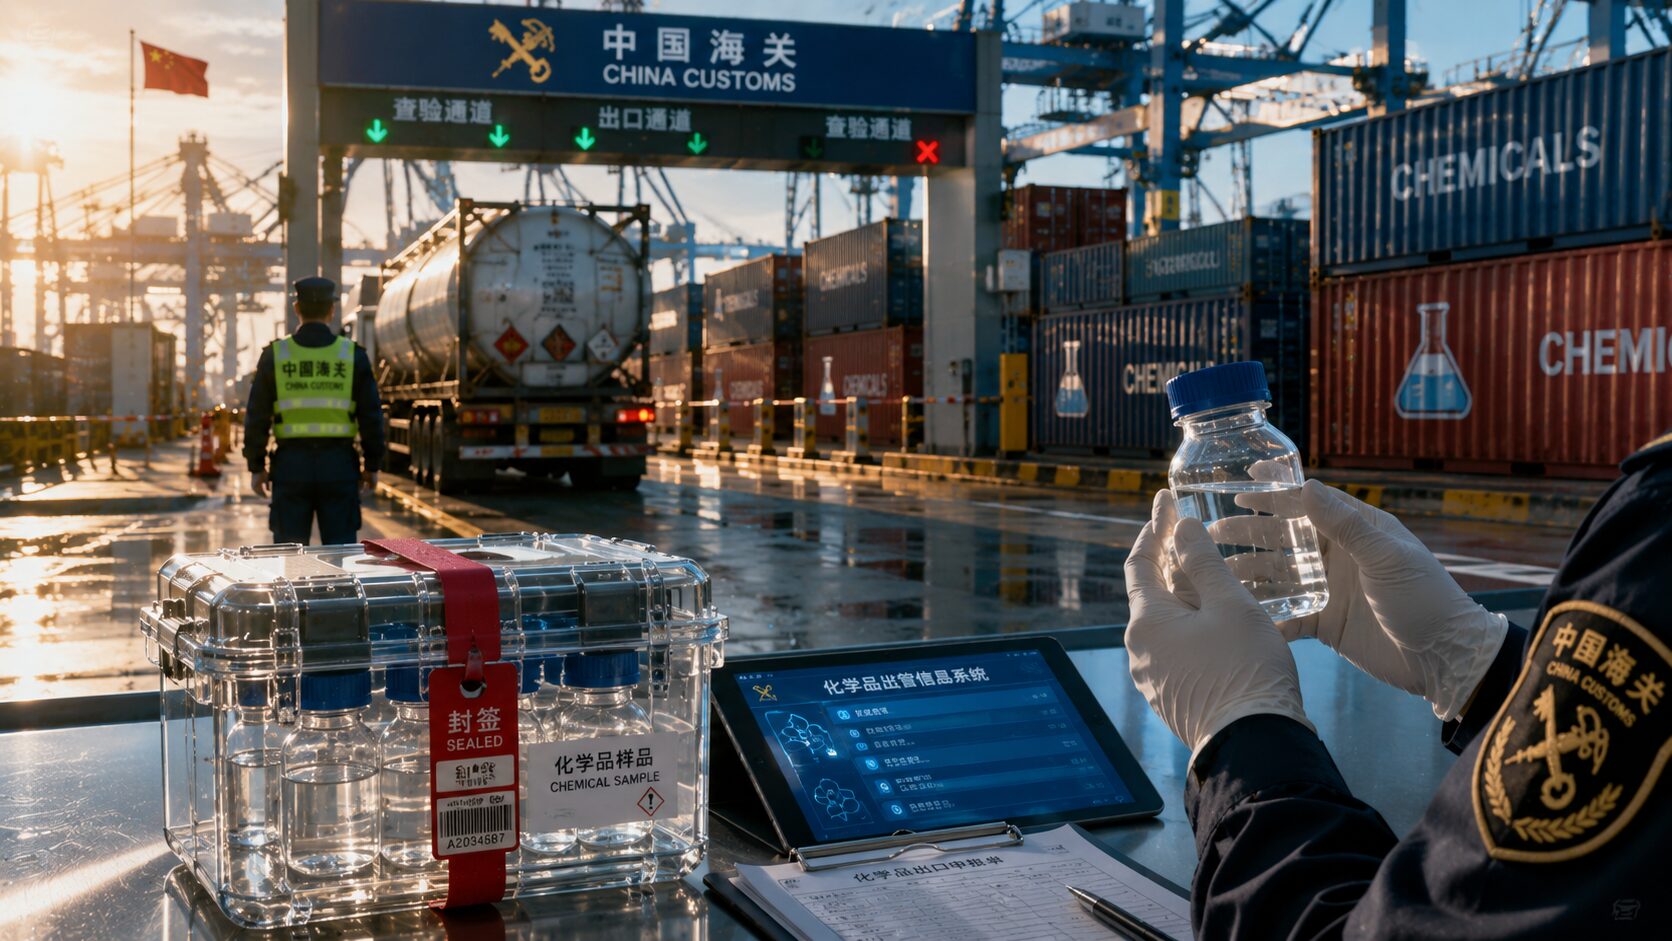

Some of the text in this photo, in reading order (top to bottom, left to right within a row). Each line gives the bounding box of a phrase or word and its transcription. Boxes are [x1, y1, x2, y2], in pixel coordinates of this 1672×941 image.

[602, 23, 797, 69] 中国海关
[602, 64, 797, 92] CHINA CUSTOMS
[393, 97, 493, 124] 查验通道
[599, 106, 692, 131] 出口通道
[826, 115, 912, 141] 查验通道
[1391, 125, 1601, 201] CHEMICALS
[1538, 326, 1672, 376] CHEMI
[1552, 622, 1666, 715] 中国海关
[1546, 661, 1637, 728] CHINA CUSTOMS
[448, 706, 501, 734] 封签
[447, 735, 503, 752] SEALED
[555, 747, 653, 776] 化学品样品
[550, 771, 660, 793] CHEMICAL SAMPLE
